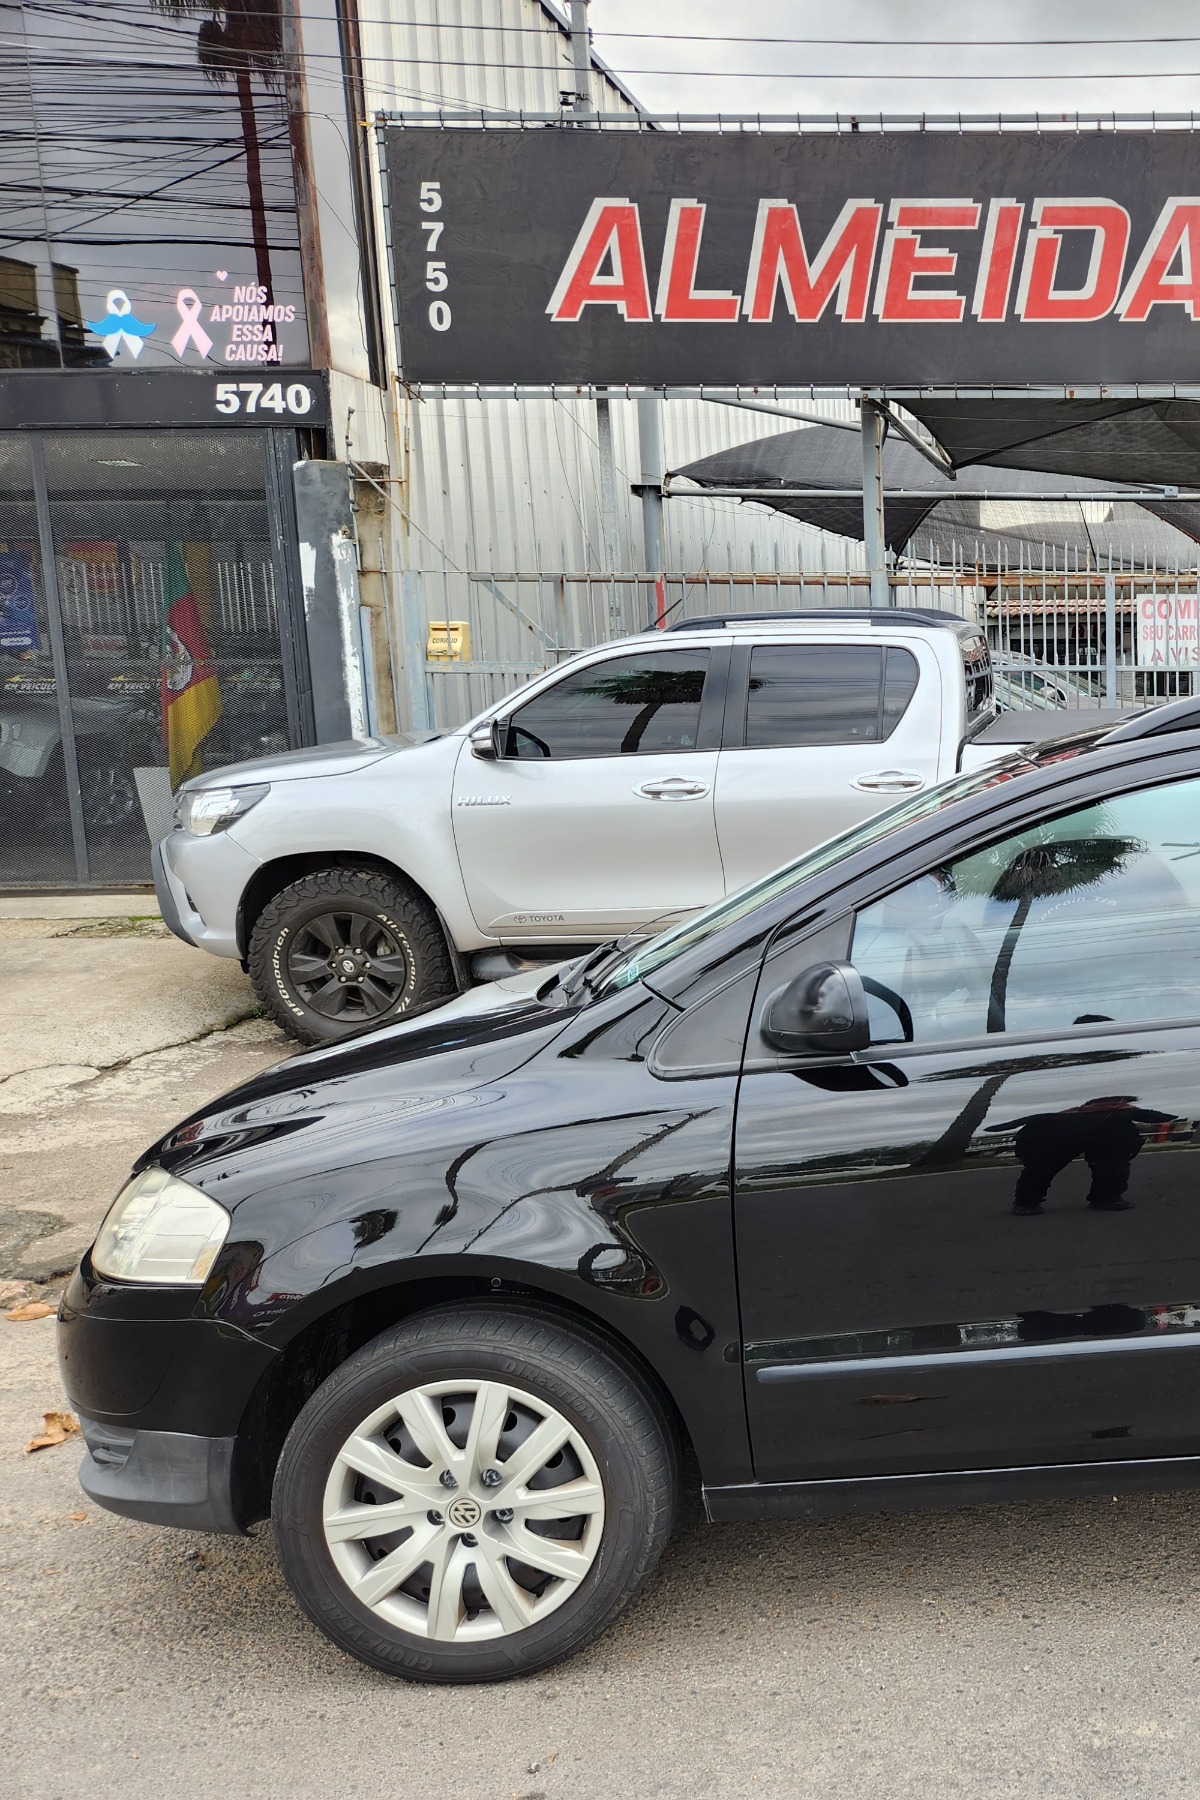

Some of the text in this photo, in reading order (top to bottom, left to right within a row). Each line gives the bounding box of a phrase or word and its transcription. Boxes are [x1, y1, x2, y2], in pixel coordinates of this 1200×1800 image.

[233, 281, 268, 303] NÓS
[210, 304, 296, 323] APOIAMOS
[231, 324, 273, 342] ESSA
[224, 344, 284, 362] CAUSA!
[215, 383, 311, 414] 5740
[1142, 624, 1164, 641] SEU
[457, 795, 513, 806] HILUX
[529, 914, 565, 922] TOYOTA
[376, 913, 417, 991] All-Terrain
[271, 926, 305, 1017] BFGoodrich
